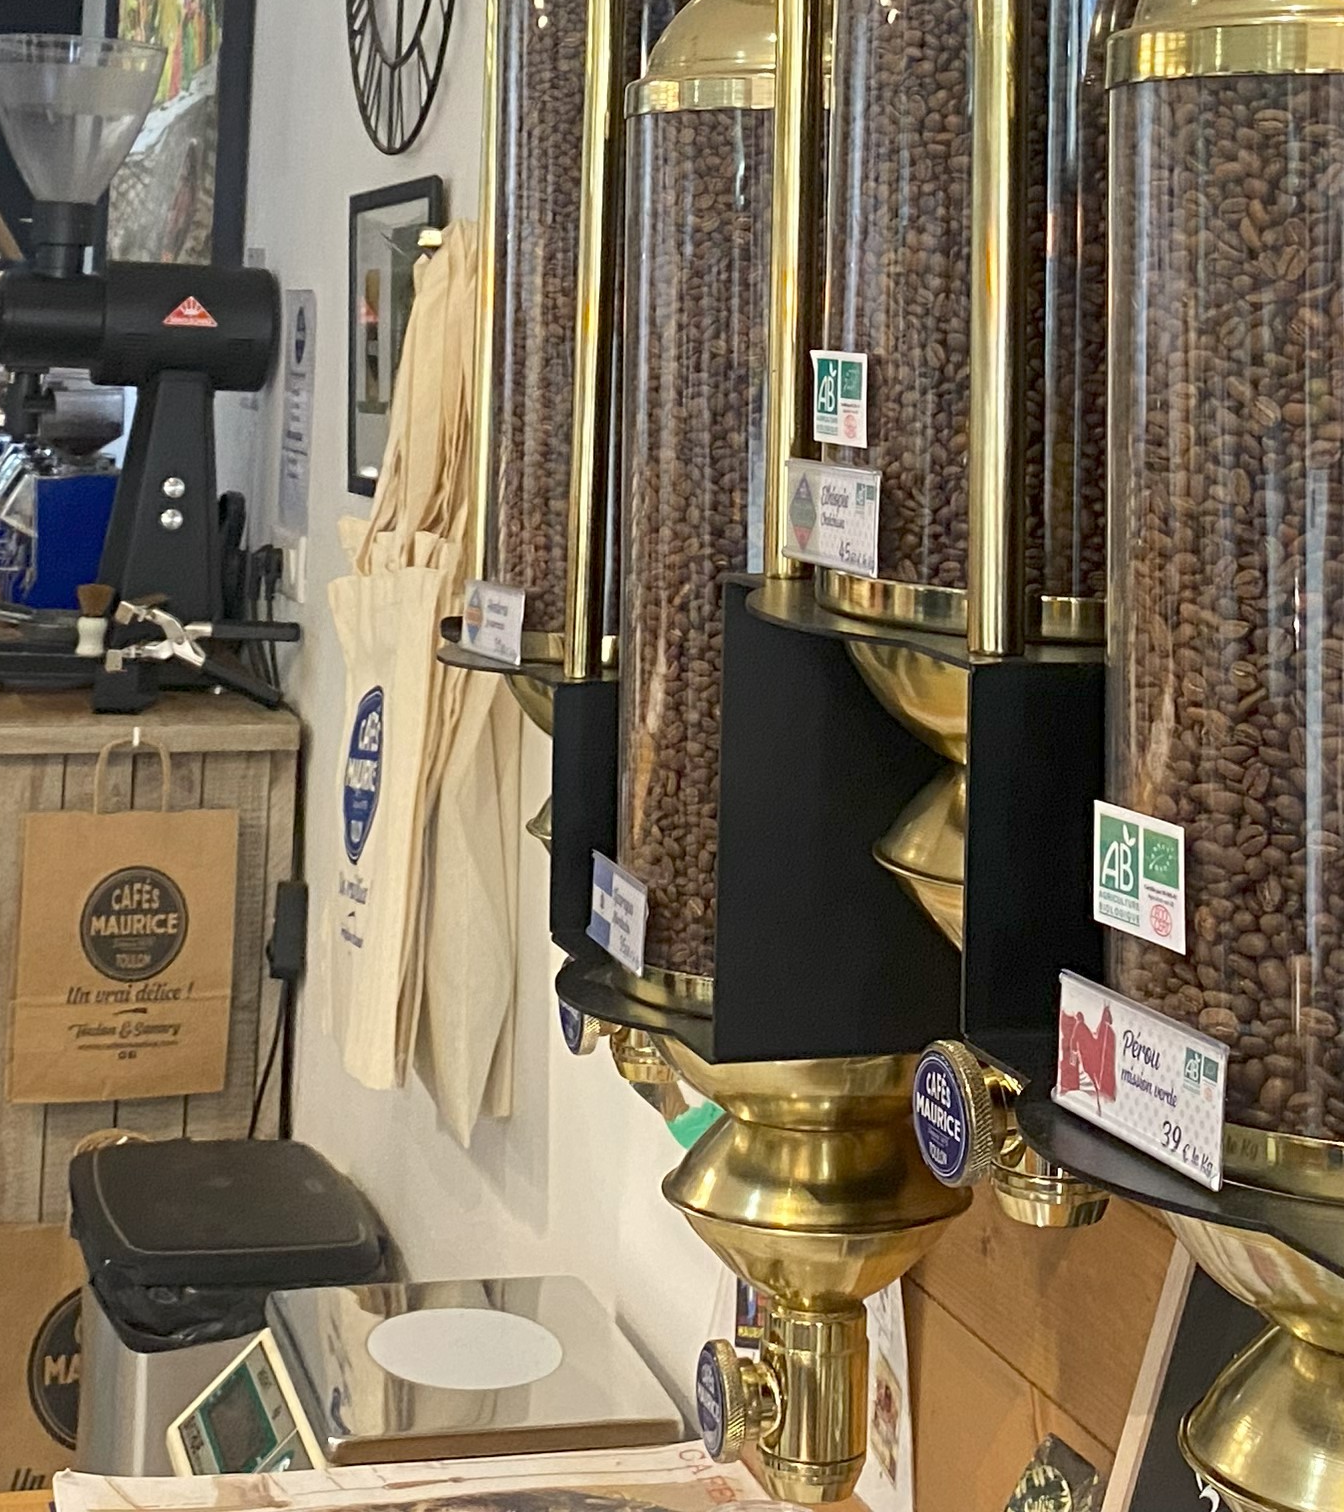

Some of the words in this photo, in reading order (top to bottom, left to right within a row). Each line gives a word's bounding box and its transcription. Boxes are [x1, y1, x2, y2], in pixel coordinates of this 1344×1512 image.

[1102, 840, 1134, 892] AB
[111, 879, 161, 910] CAFÉS
[90, 912, 179, 937] MAURICE
[1099, 901, 1140, 924] BIOLOGIQUE
[66, 986, 91, 1005] Un
[95, 984, 132, 1004] vrai
[135, 982, 181, 1004] délice
[1122, 1029, 1161, 1071] Pérou
[925, 1071, 952, 1109] CAFÉS
[1121, 1067, 1153, 1097] mission
[916, 1091, 962, 1143] MAURICE
[1161, 1120, 1182, 1153] 39
